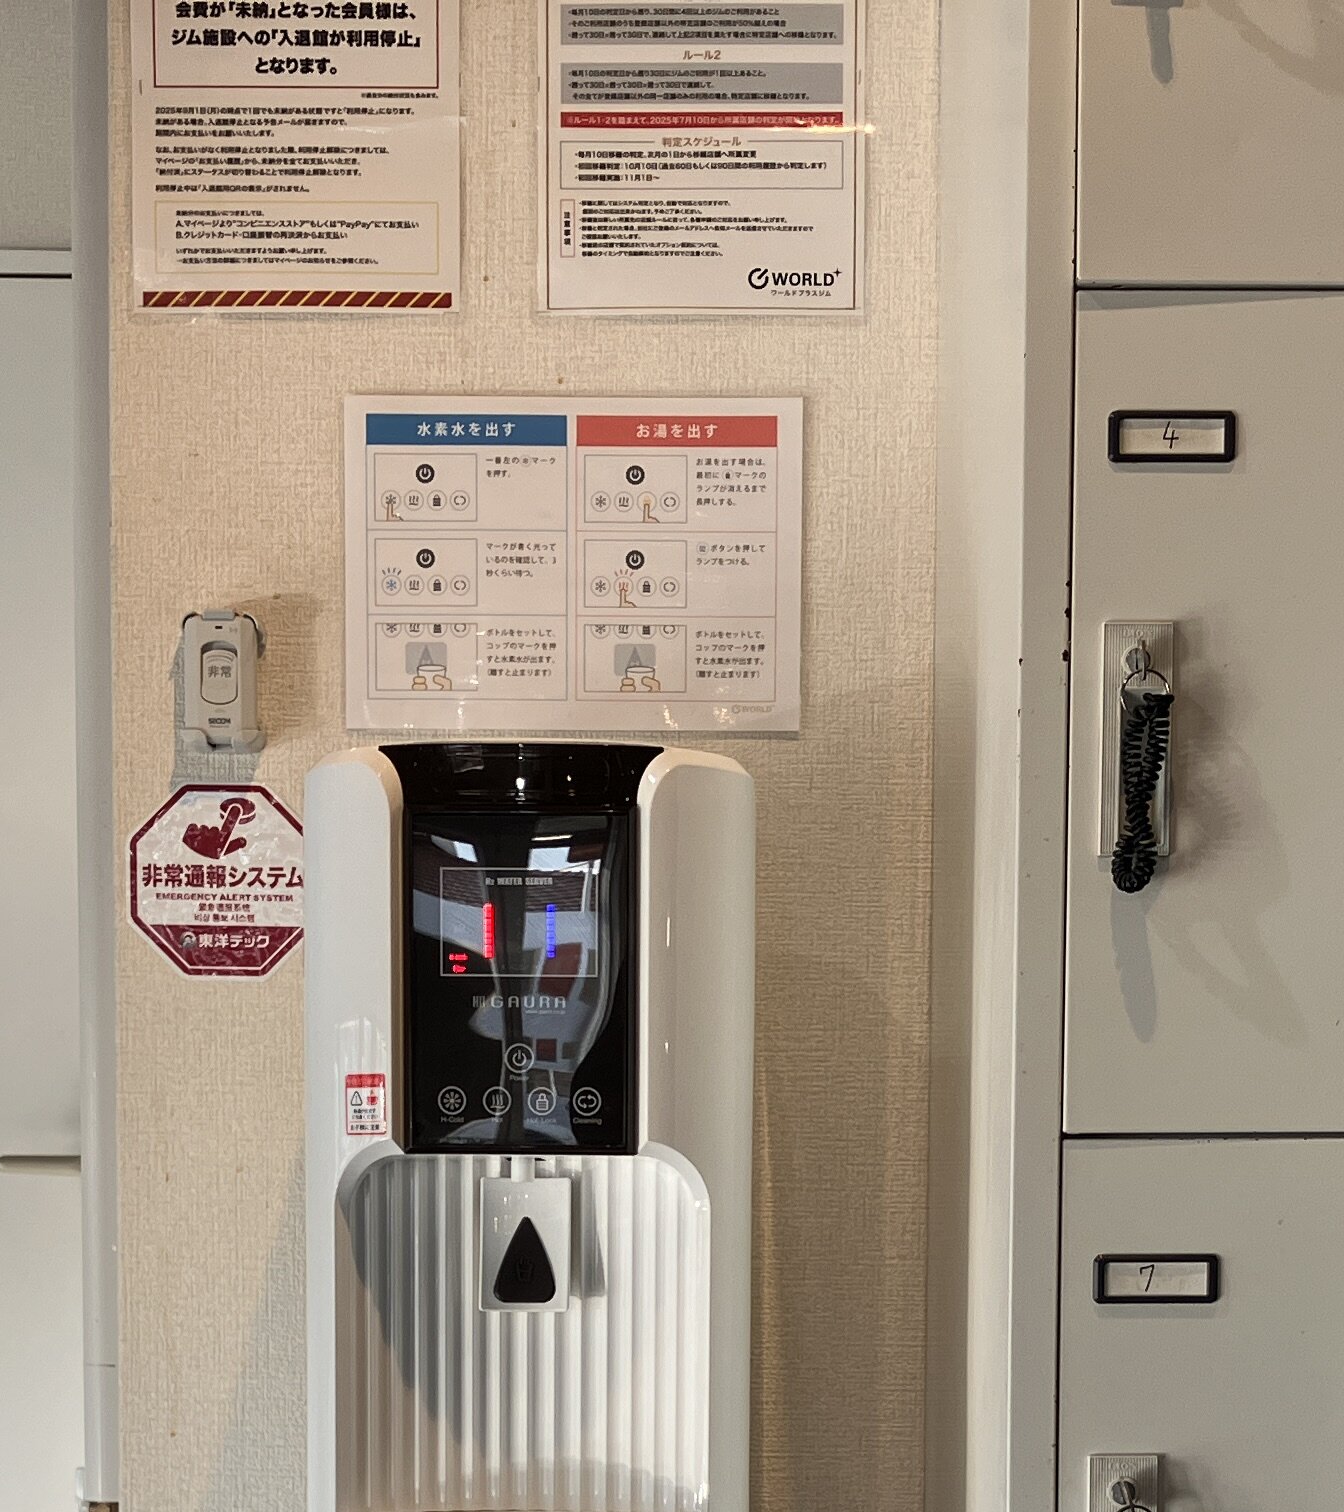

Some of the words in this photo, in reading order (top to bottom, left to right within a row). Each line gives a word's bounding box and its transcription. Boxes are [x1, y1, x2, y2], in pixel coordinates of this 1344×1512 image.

[175, 1, 416, 19] 会費が「未納」となった会員様は、
[171, 29, 421, 48] ジム施設への「入退館が利用停止」
[682, 50, 721, 60] ルール2
[255, 57, 337, 75] となります。
[661, 137, 742, 147] 判定スケジュール
[416, 421, 516, 438] 水素水を出す
[636, 423, 719, 439] お湯を出す
[1162, 421, 1180, 450] 4
[735, 471, 767, 480] マークの
[696, 558, 750, 566] ランプをつける。
[208, 665, 232, 678] 非常
[142, 863, 304, 889] 非常通報システム
[156, 893, 217, 901] EMERGENCY
[219, 894, 252, 902] ALERT
[253, 894, 294, 902] SYSTEM
[198, 933, 270, 949] 東洋テック
[1139, 1263, 1156, 1293] 7
